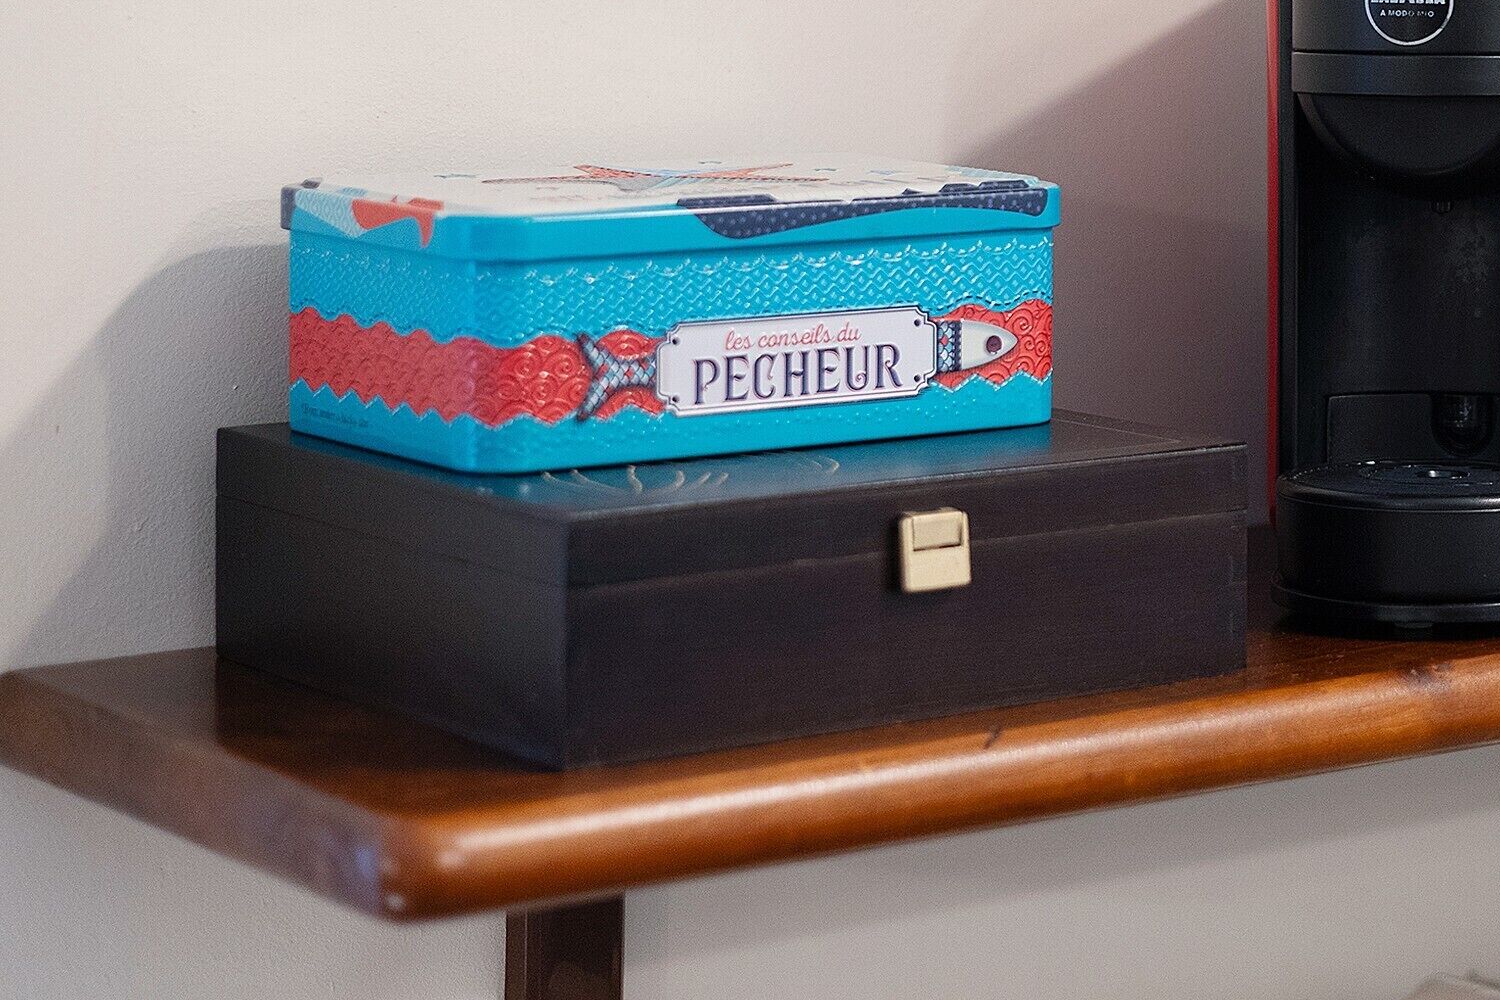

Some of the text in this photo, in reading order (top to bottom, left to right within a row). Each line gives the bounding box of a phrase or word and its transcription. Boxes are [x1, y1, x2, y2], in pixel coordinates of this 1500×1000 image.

[1380, 9, 1386, 17] A
[1388, 9, 1415, 17] MODO
[724, 320, 862, 351] les conseils du
[693, 343, 904, 406] PECHEUR
